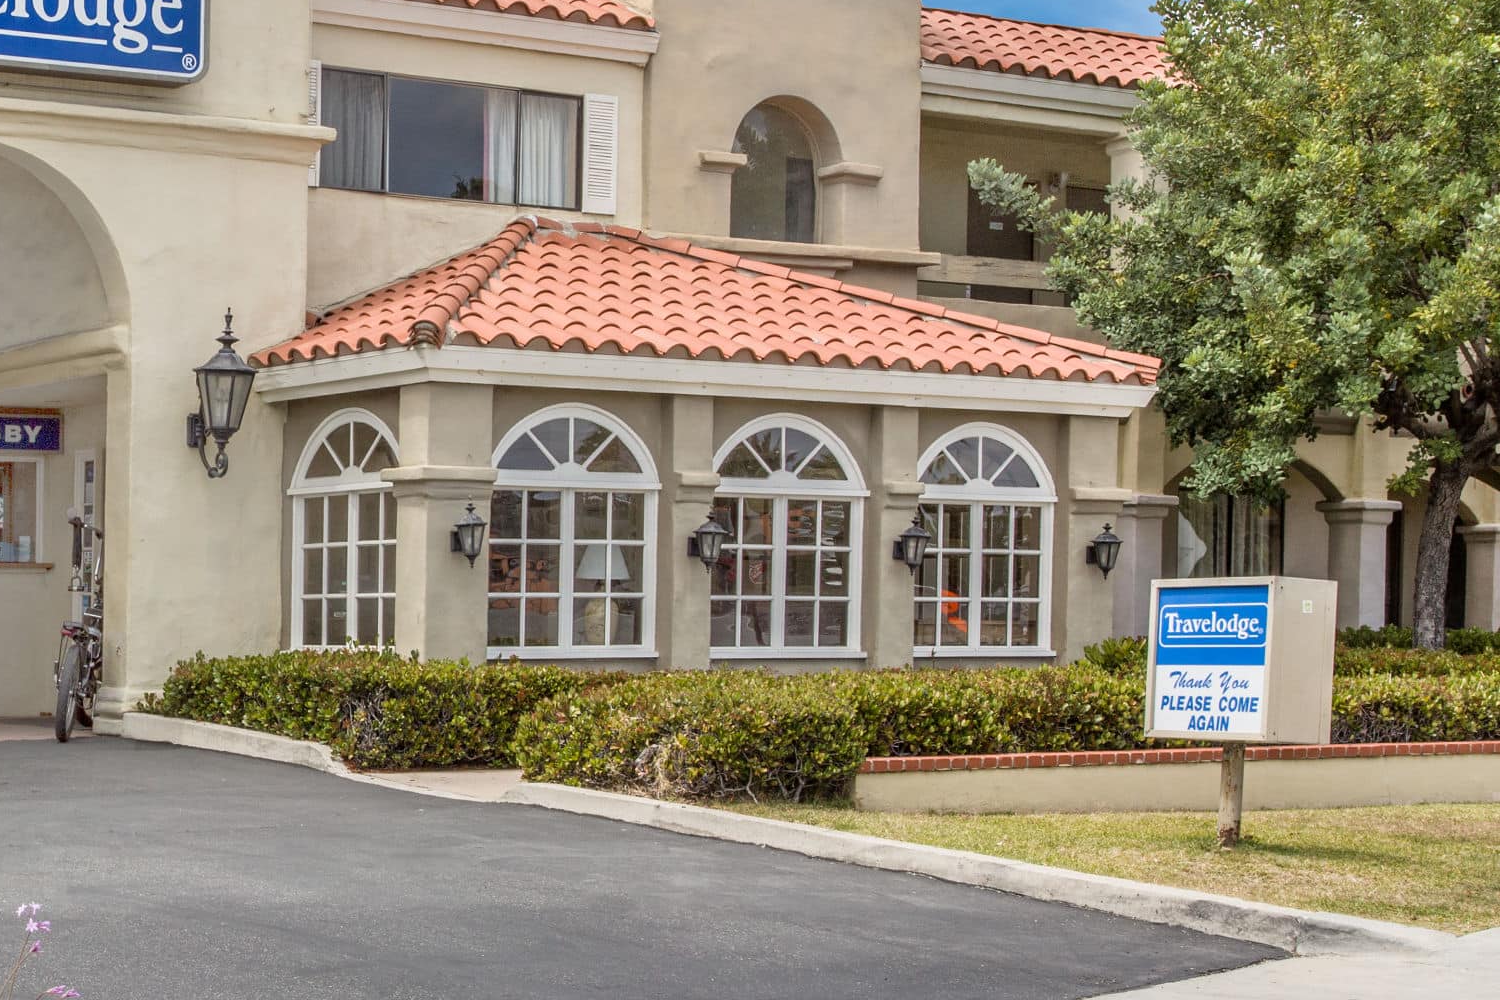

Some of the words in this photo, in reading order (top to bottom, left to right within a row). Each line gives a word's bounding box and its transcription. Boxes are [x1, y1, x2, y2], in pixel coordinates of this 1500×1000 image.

[1164, 611, 1260, 640] Travelodge
[1169, 671, 1213, 690] Thank
[1218, 670, 1250, 694] You
[1160, 695, 1213, 712] PLEASE
[1218, 696, 1259, 713] COME
[1187, 714, 1230, 732] AGAIN
